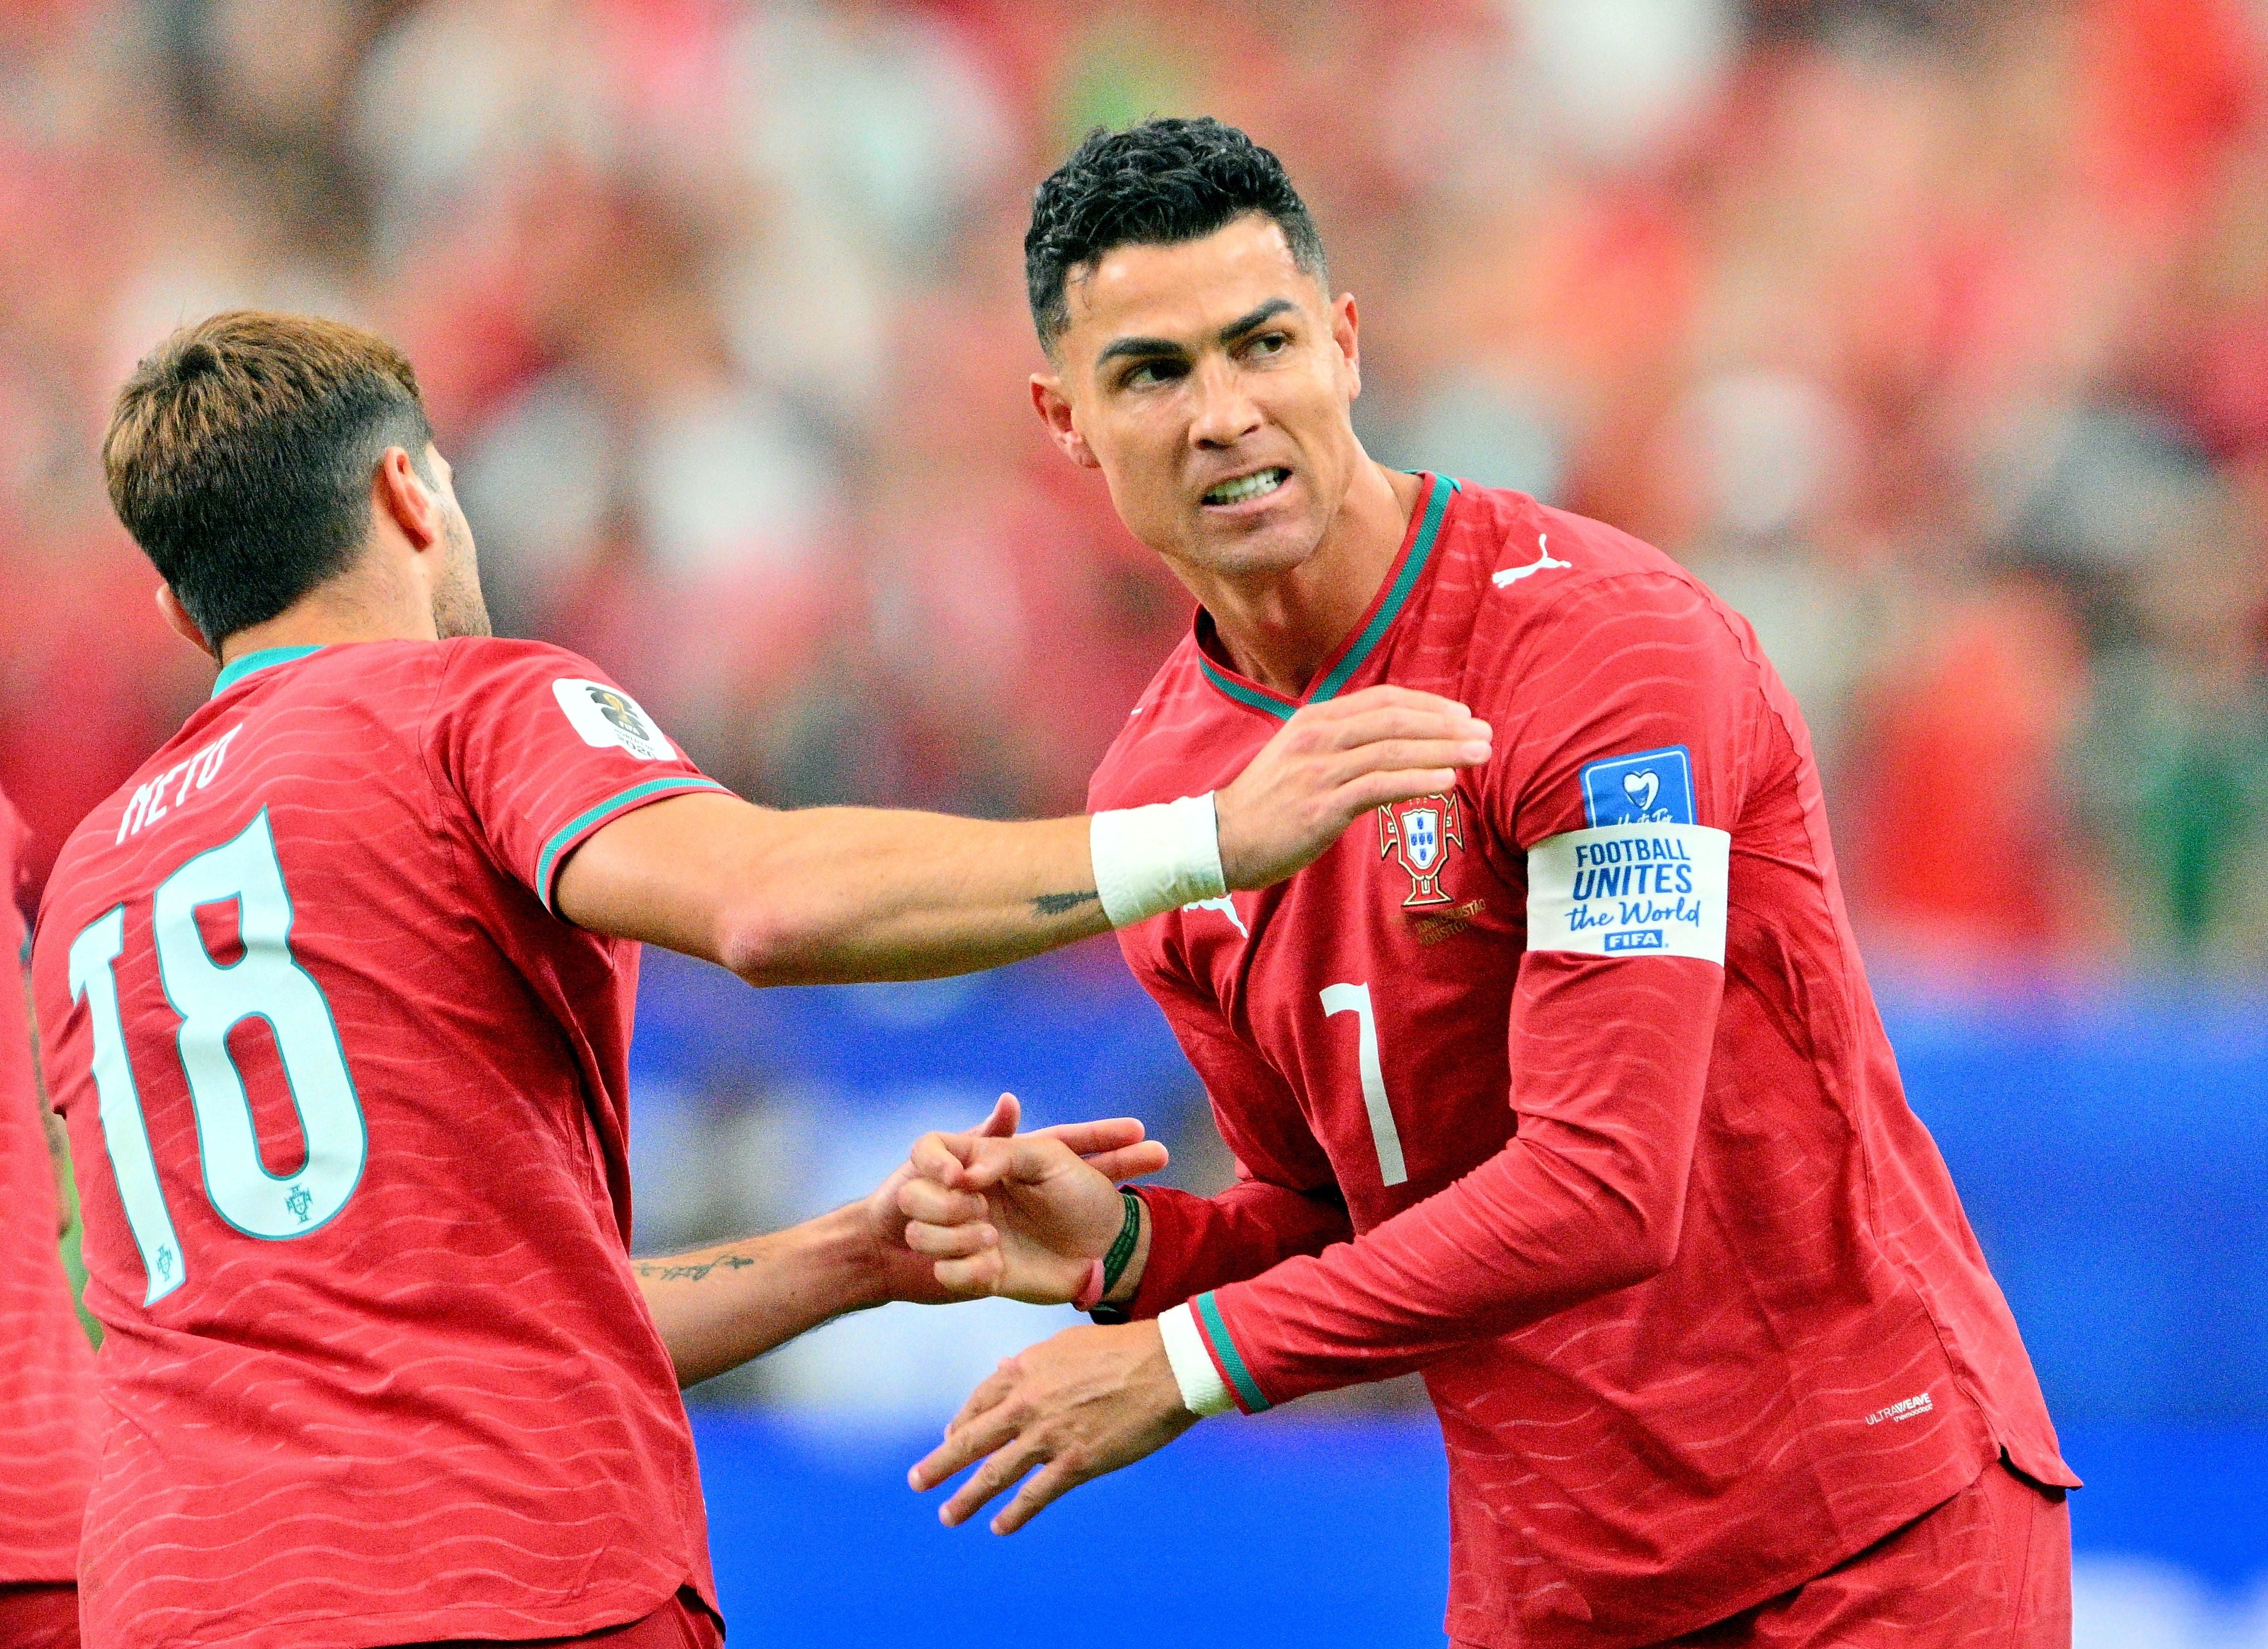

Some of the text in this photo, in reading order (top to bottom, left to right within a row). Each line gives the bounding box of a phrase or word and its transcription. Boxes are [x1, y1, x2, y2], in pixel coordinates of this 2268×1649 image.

[115, 723, 242, 845] NETO
[1575, 838, 1691, 868] FOOTBALL
[1572, 864, 1692, 901] UNITES
[1565, 897, 1701, 931] the World
[1609, 931, 1661, 949] FIFA
[68, 802, 367, 1308] 18
[1319, 981, 1408, 1187] 7
[1864, 1393, 1932, 1425] ULTRAWEAVE
